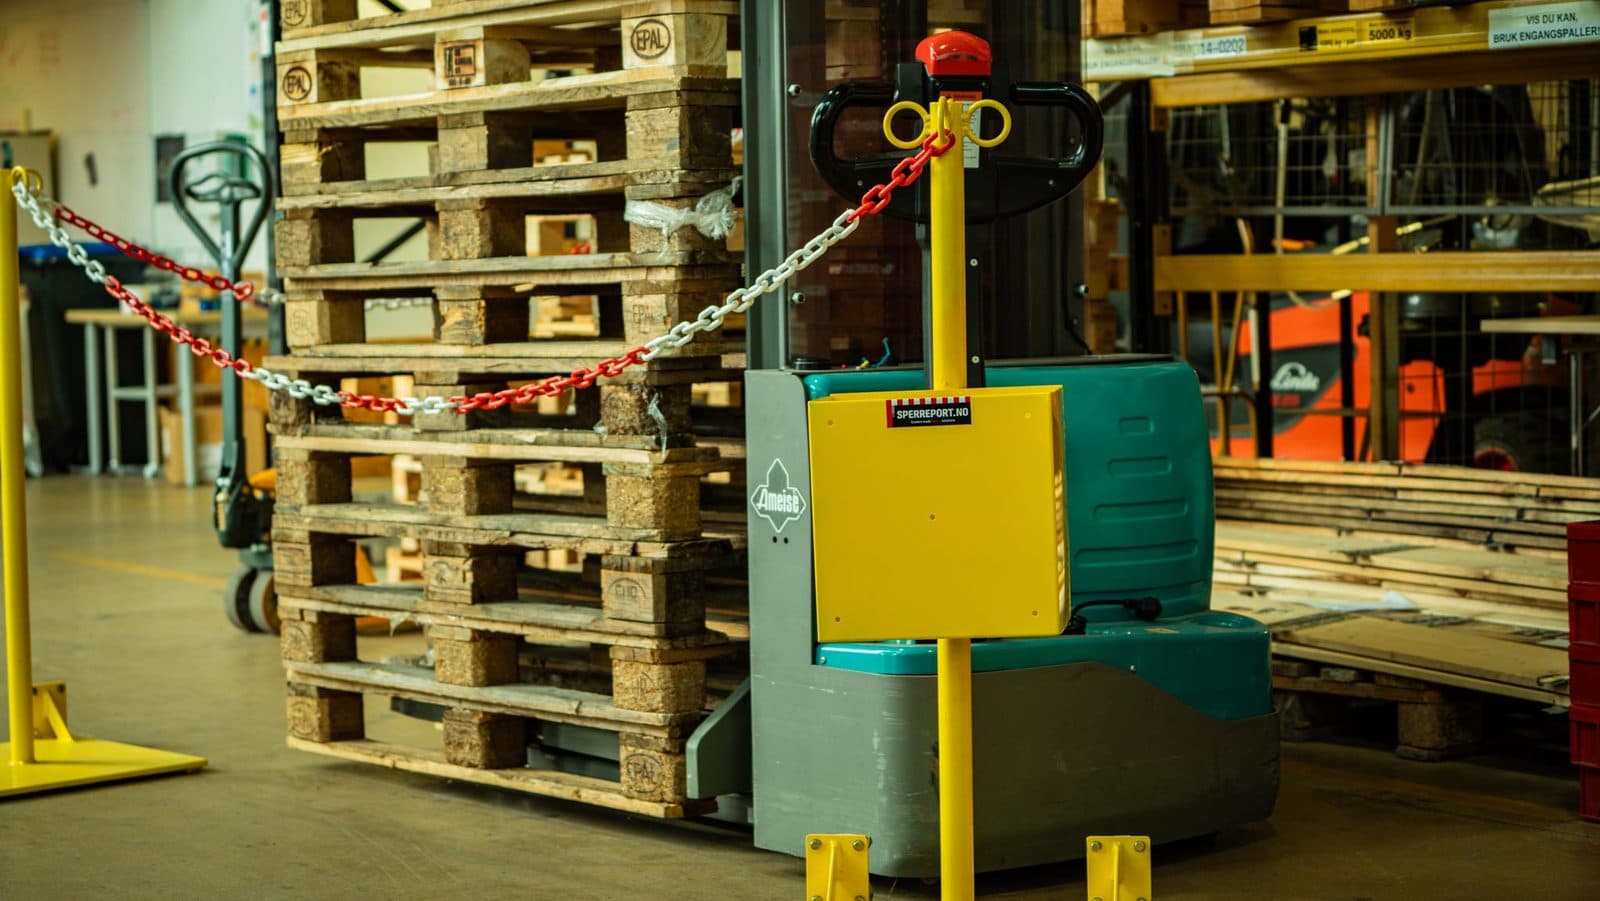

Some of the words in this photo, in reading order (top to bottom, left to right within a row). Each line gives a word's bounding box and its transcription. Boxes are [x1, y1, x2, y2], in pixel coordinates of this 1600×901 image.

[1526, 15, 1540, 25] VIS
[1542, 14, 1555, 24] DU
[1557, 12, 1578, 23] KAN,
[635, 26, 665, 51] EPAL
[1368, 28, 1396, 41] 5000
[1398, 25, 1412, 41] kg
[1493, 32, 1519, 43] BRUK
[896, 407, 970, 420] SPERREPORT.NO
[756, 487, 800, 514] Ameise
